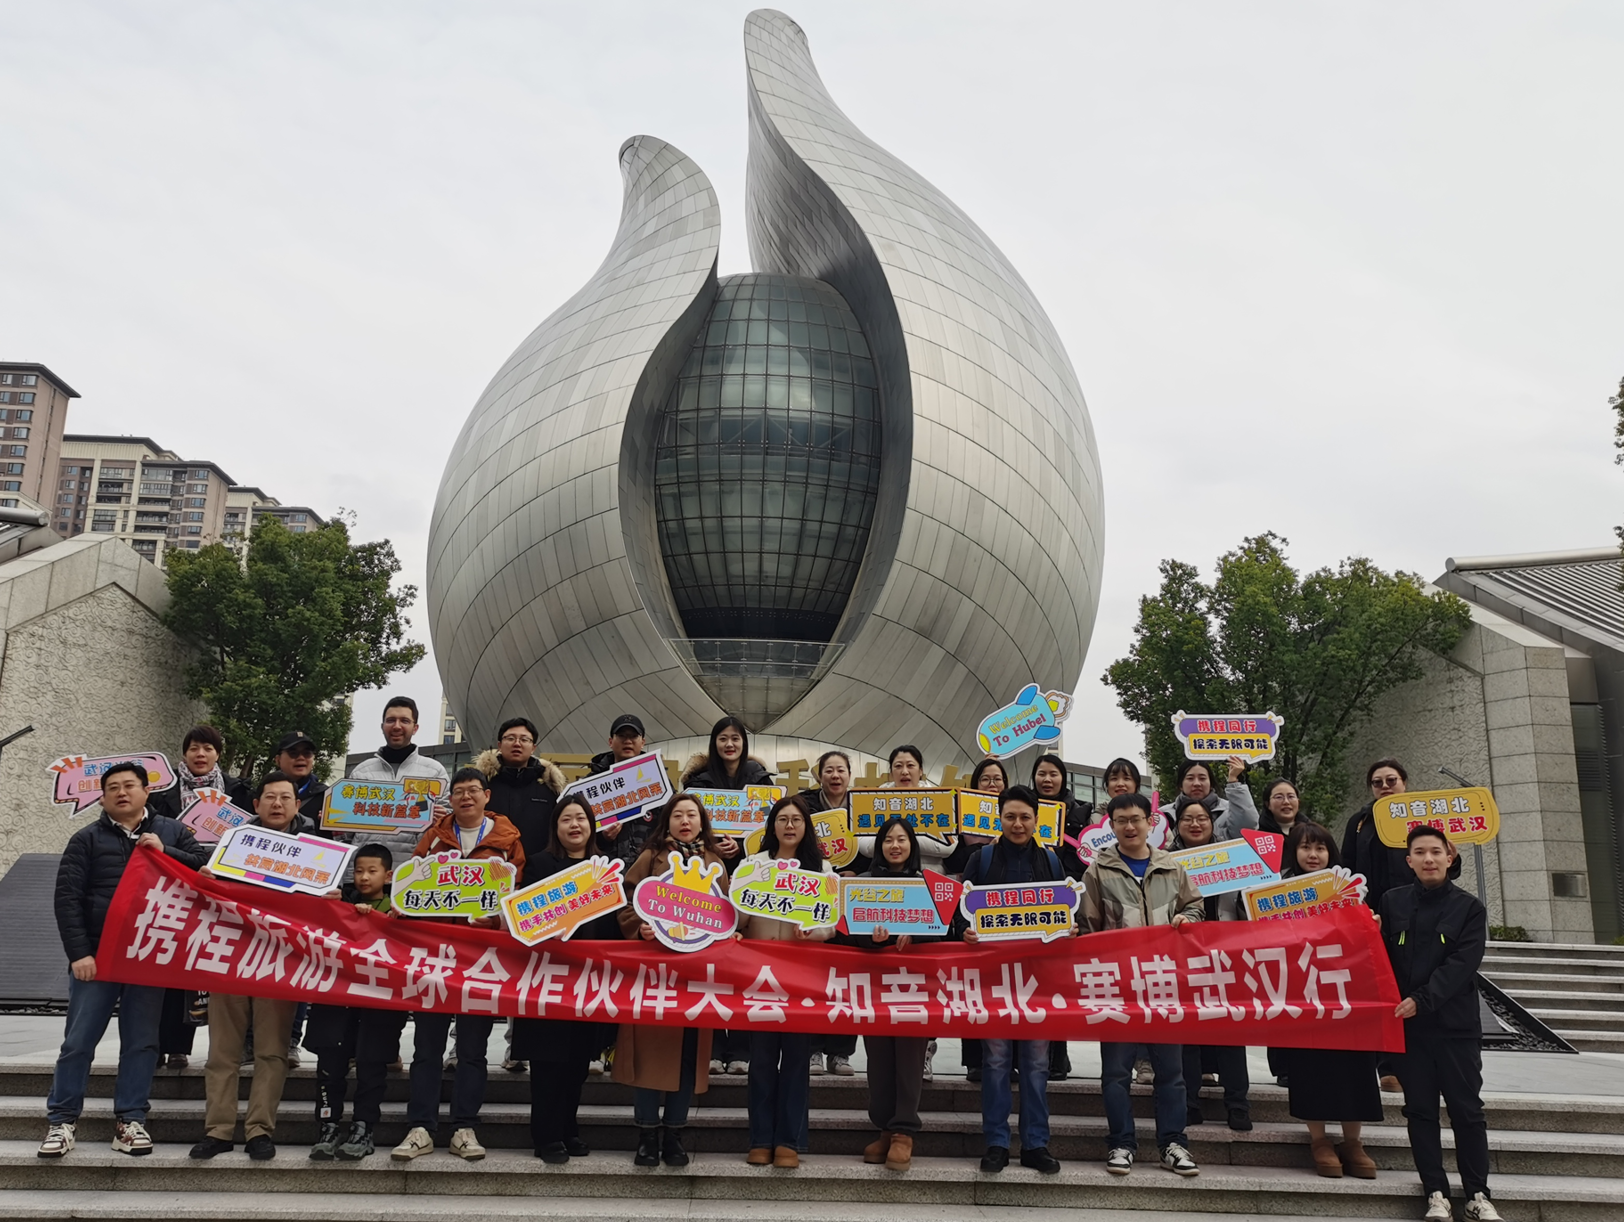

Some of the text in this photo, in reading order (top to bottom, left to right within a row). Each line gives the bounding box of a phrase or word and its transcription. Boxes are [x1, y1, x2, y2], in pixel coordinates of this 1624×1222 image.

[988, 705, 1038, 734] Welcome
[1197, 720, 1257, 732] 携程同行
[993, 735, 1010, 747] To
[1193, 738, 1268, 750] 探索无限可能
[342, 785, 395, 800] 赛博武汉
[352, 802, 421, 819] 科技新篇章
[873, 798, 934, 811] 知音湖北
[1389, 797, 1470, 818] 知音湖北
[240, 834, 301, 857] 携程伙伴
[244, 853, 331, 884] 共赏湖北风采
[437, 865, 485, 886] 武汉
[774, 873, 821, 898] 武汉
[850, 887, 906, 903] 光谷之旅
[404, 889, 498, 910] 每天不一样
[516, 880, 578, 916] 携程旅游
[656, 885, 722, 913] Welcome
[741, 889, 831, 922] 每天不一样
[986, 888, 1054, 906] 携程同行
[1257, 887, 1318, 912] 携程旅游
[519, 884, 615, 932] 携手共创 美好未来
[648, 899, 722, 929] To Wuhan
[853, 907, 934, 924] 启航科技梦想
[981, 910, 1067, 928] 探索无限可能
